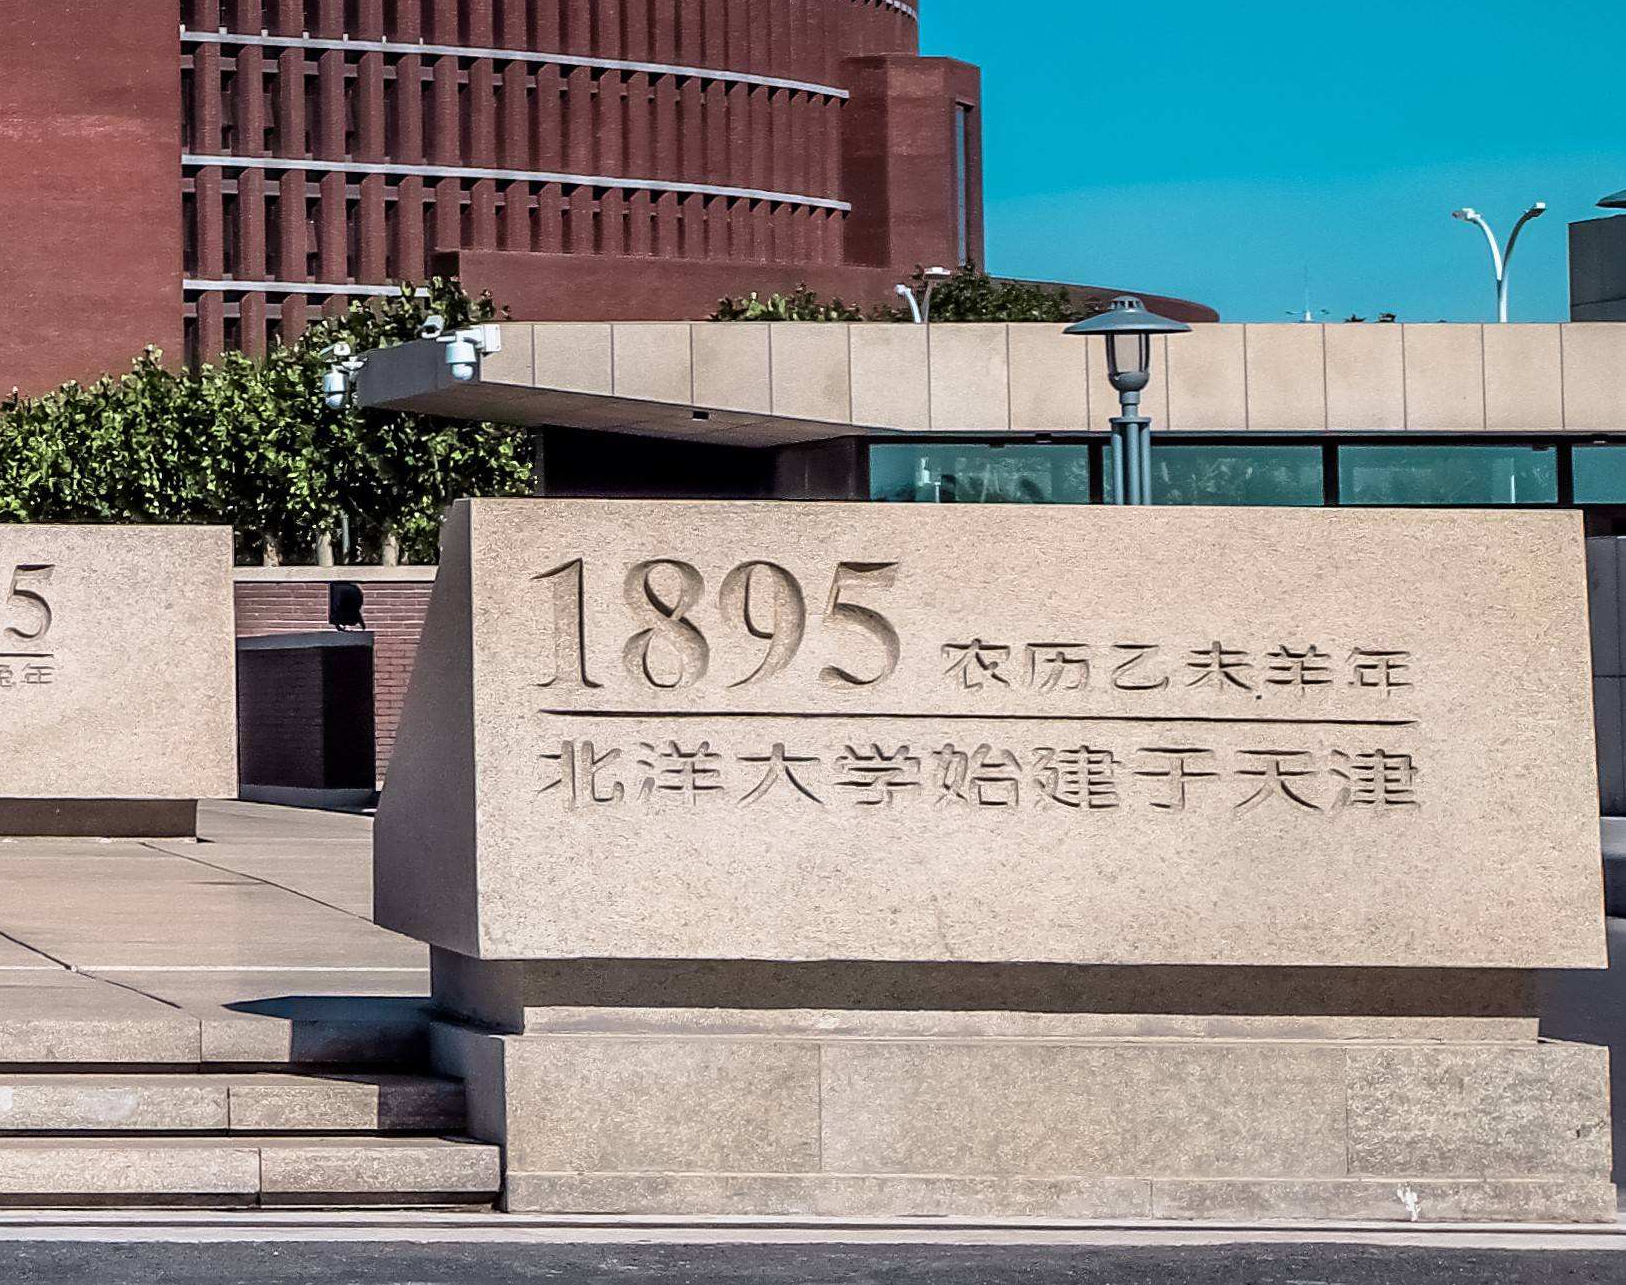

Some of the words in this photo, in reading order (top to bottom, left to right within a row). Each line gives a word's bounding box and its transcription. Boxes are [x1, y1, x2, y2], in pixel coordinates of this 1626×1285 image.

[530, 557, 901, 690] 1895
[941, 638, 1413, 698] 农历乙未羊年
[537, 739, 1423, 813] 北洋大学始建于天津
